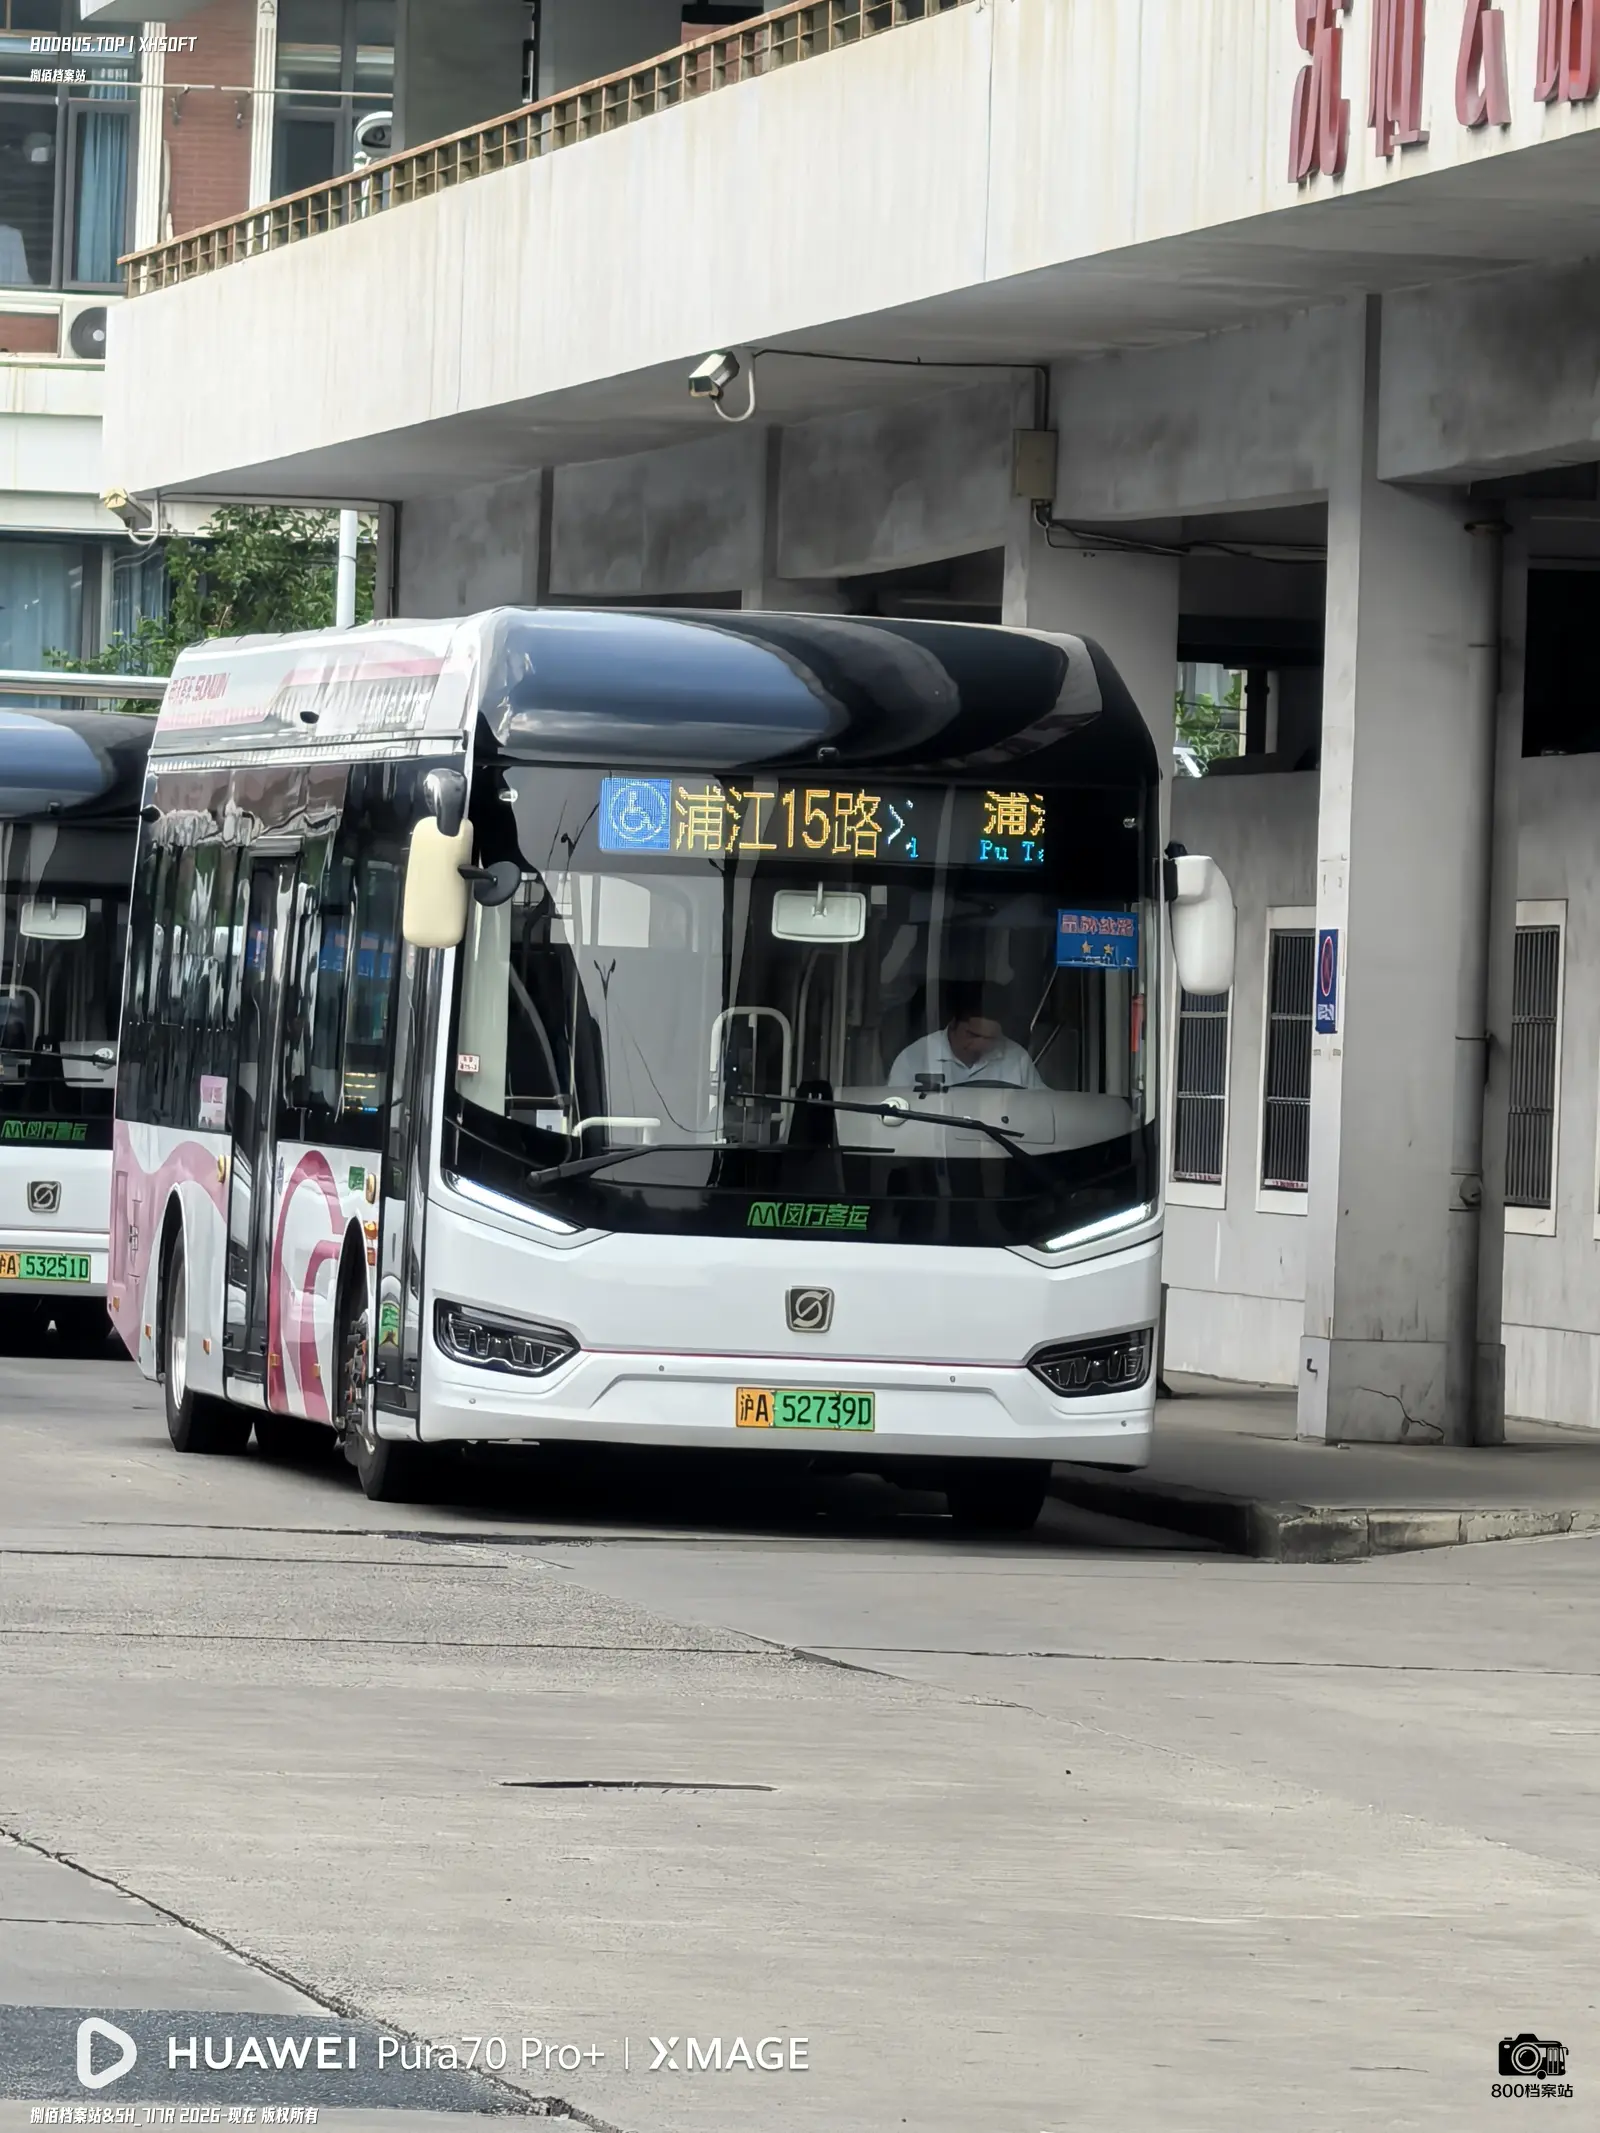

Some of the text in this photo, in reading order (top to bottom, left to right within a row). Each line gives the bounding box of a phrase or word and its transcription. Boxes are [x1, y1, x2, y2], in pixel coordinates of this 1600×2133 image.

[675, 785, 882, 858] 浦江15路
[979, 839, 1009, 861] Pu
[782, 1202, 871, 1230] 闵行客运
